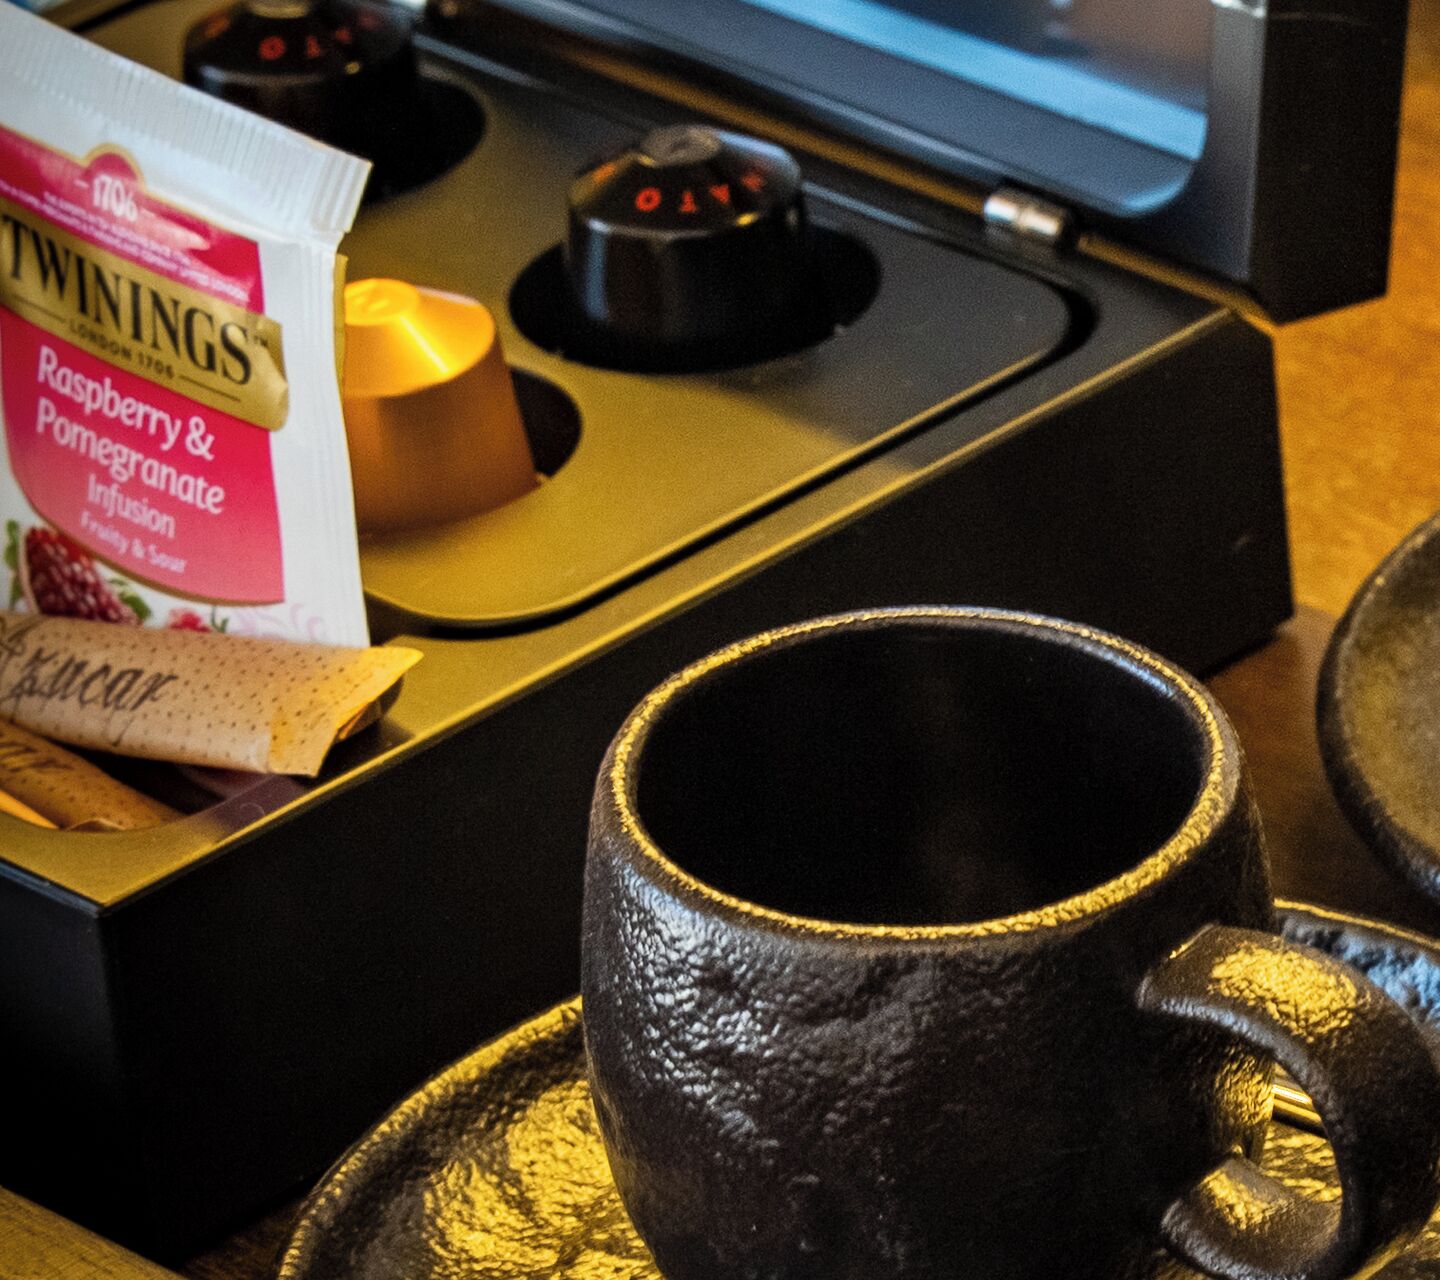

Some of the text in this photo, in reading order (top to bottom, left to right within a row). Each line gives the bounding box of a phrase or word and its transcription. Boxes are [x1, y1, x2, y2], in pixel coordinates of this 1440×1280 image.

[2, 213, 252, 386] TWININGS
[69, 318, 132, 361] LONDON
[36, 345, 215, 460] Raspberry &
[36, 396, 225, 515] Pomegranate
[87, 472, 176, 539] Infusion
